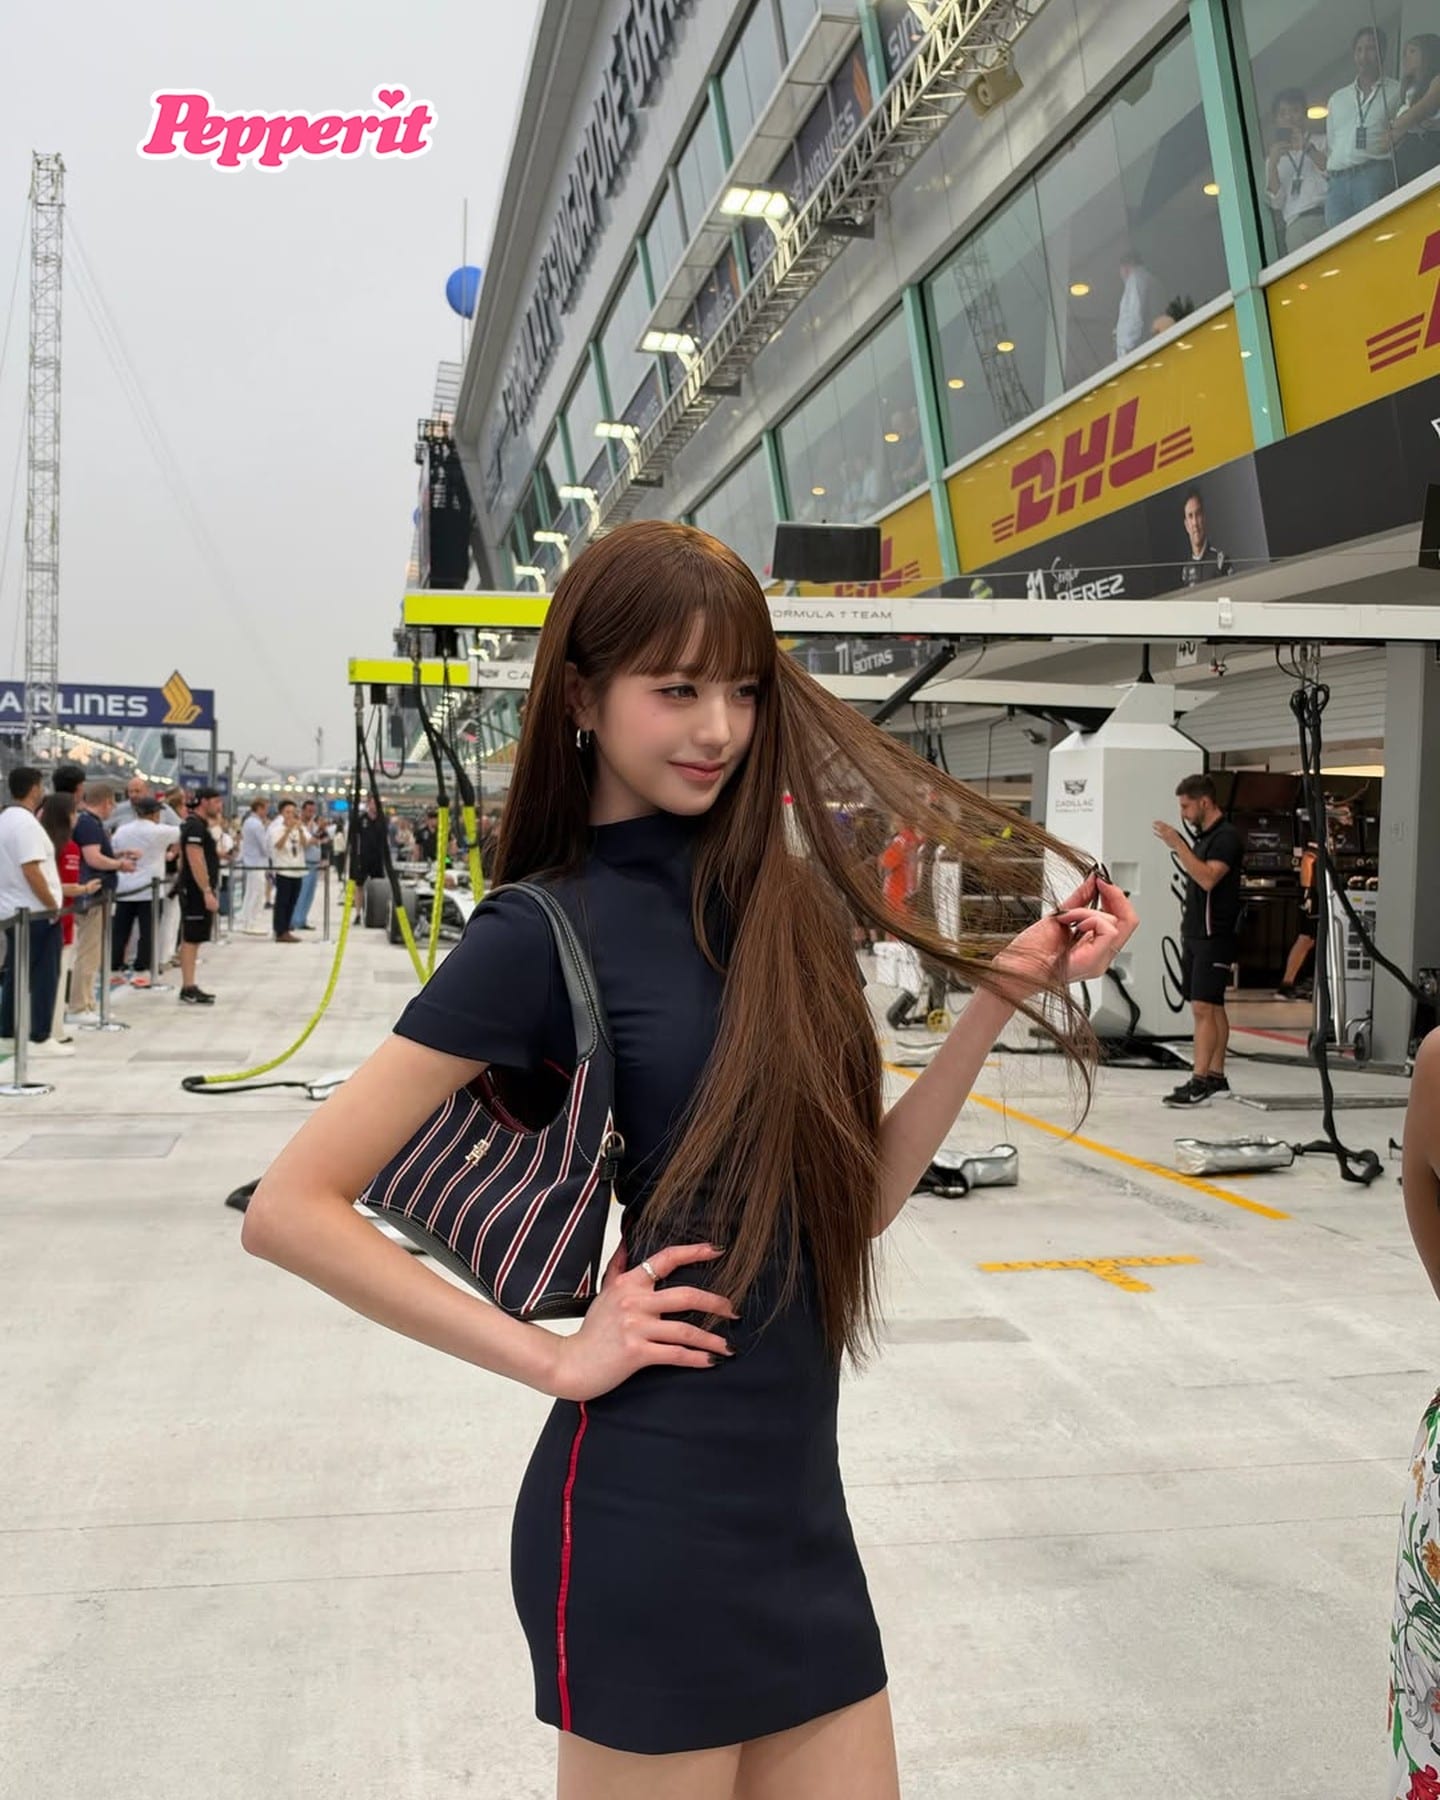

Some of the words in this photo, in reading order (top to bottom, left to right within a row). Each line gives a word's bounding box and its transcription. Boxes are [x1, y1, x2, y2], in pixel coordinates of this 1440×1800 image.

[541, 34, 632, 316] SINGAPORE
[1011, 397, 1157, 534] DHL
[772, 609, 835, 619] ORMULA
[851, 610, 893, 620] TEAM
[853, 649, 893, 674] BOTTAS
[0, 690, 149, 717] ARLINES
